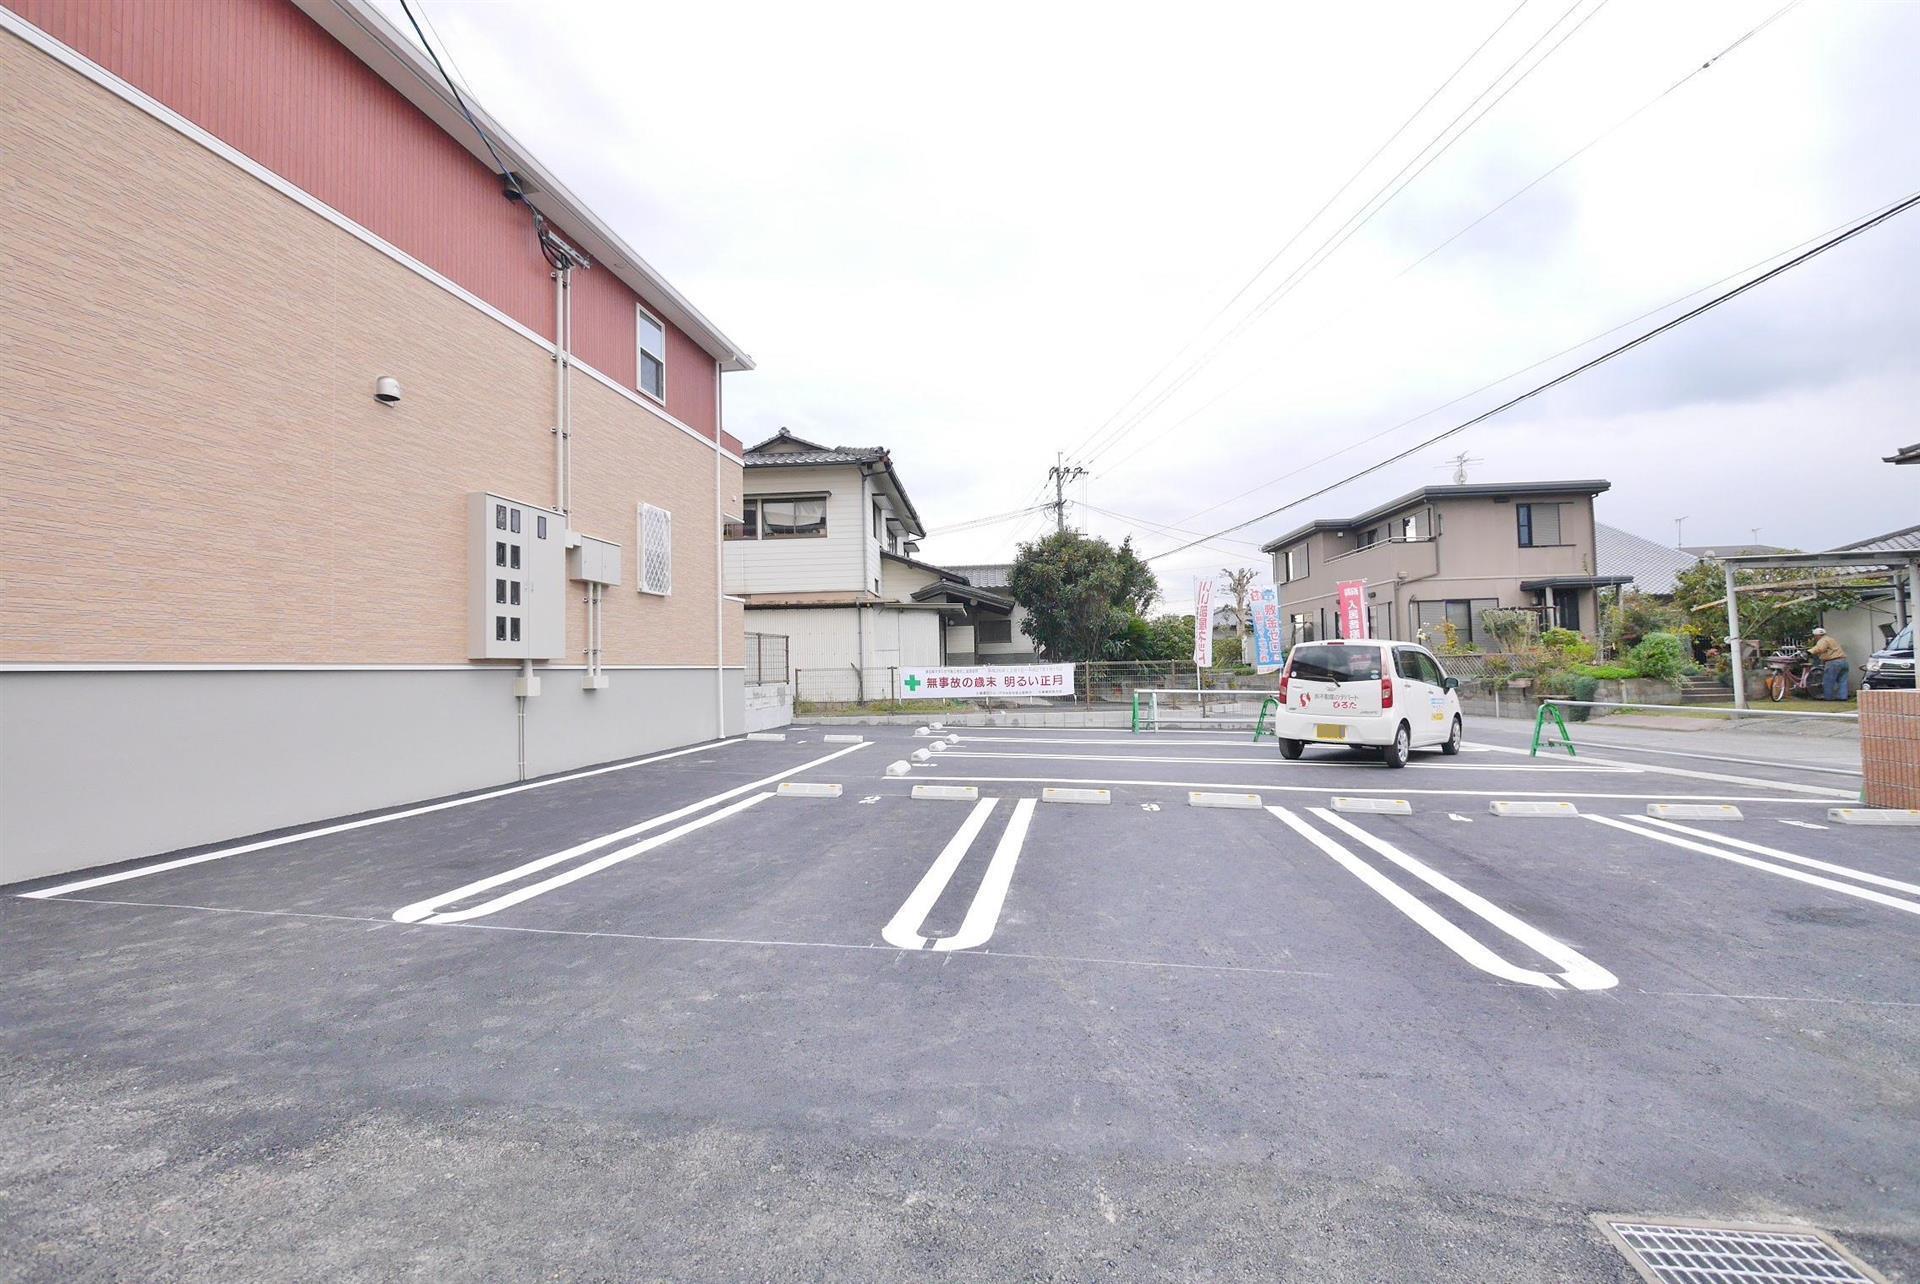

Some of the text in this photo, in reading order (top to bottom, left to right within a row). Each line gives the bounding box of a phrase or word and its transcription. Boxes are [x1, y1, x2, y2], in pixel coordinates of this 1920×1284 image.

[926, 674, 1064, 689] 無事故の歳末 明るい正月
[1333, 701, 1357, 709] ひろた
